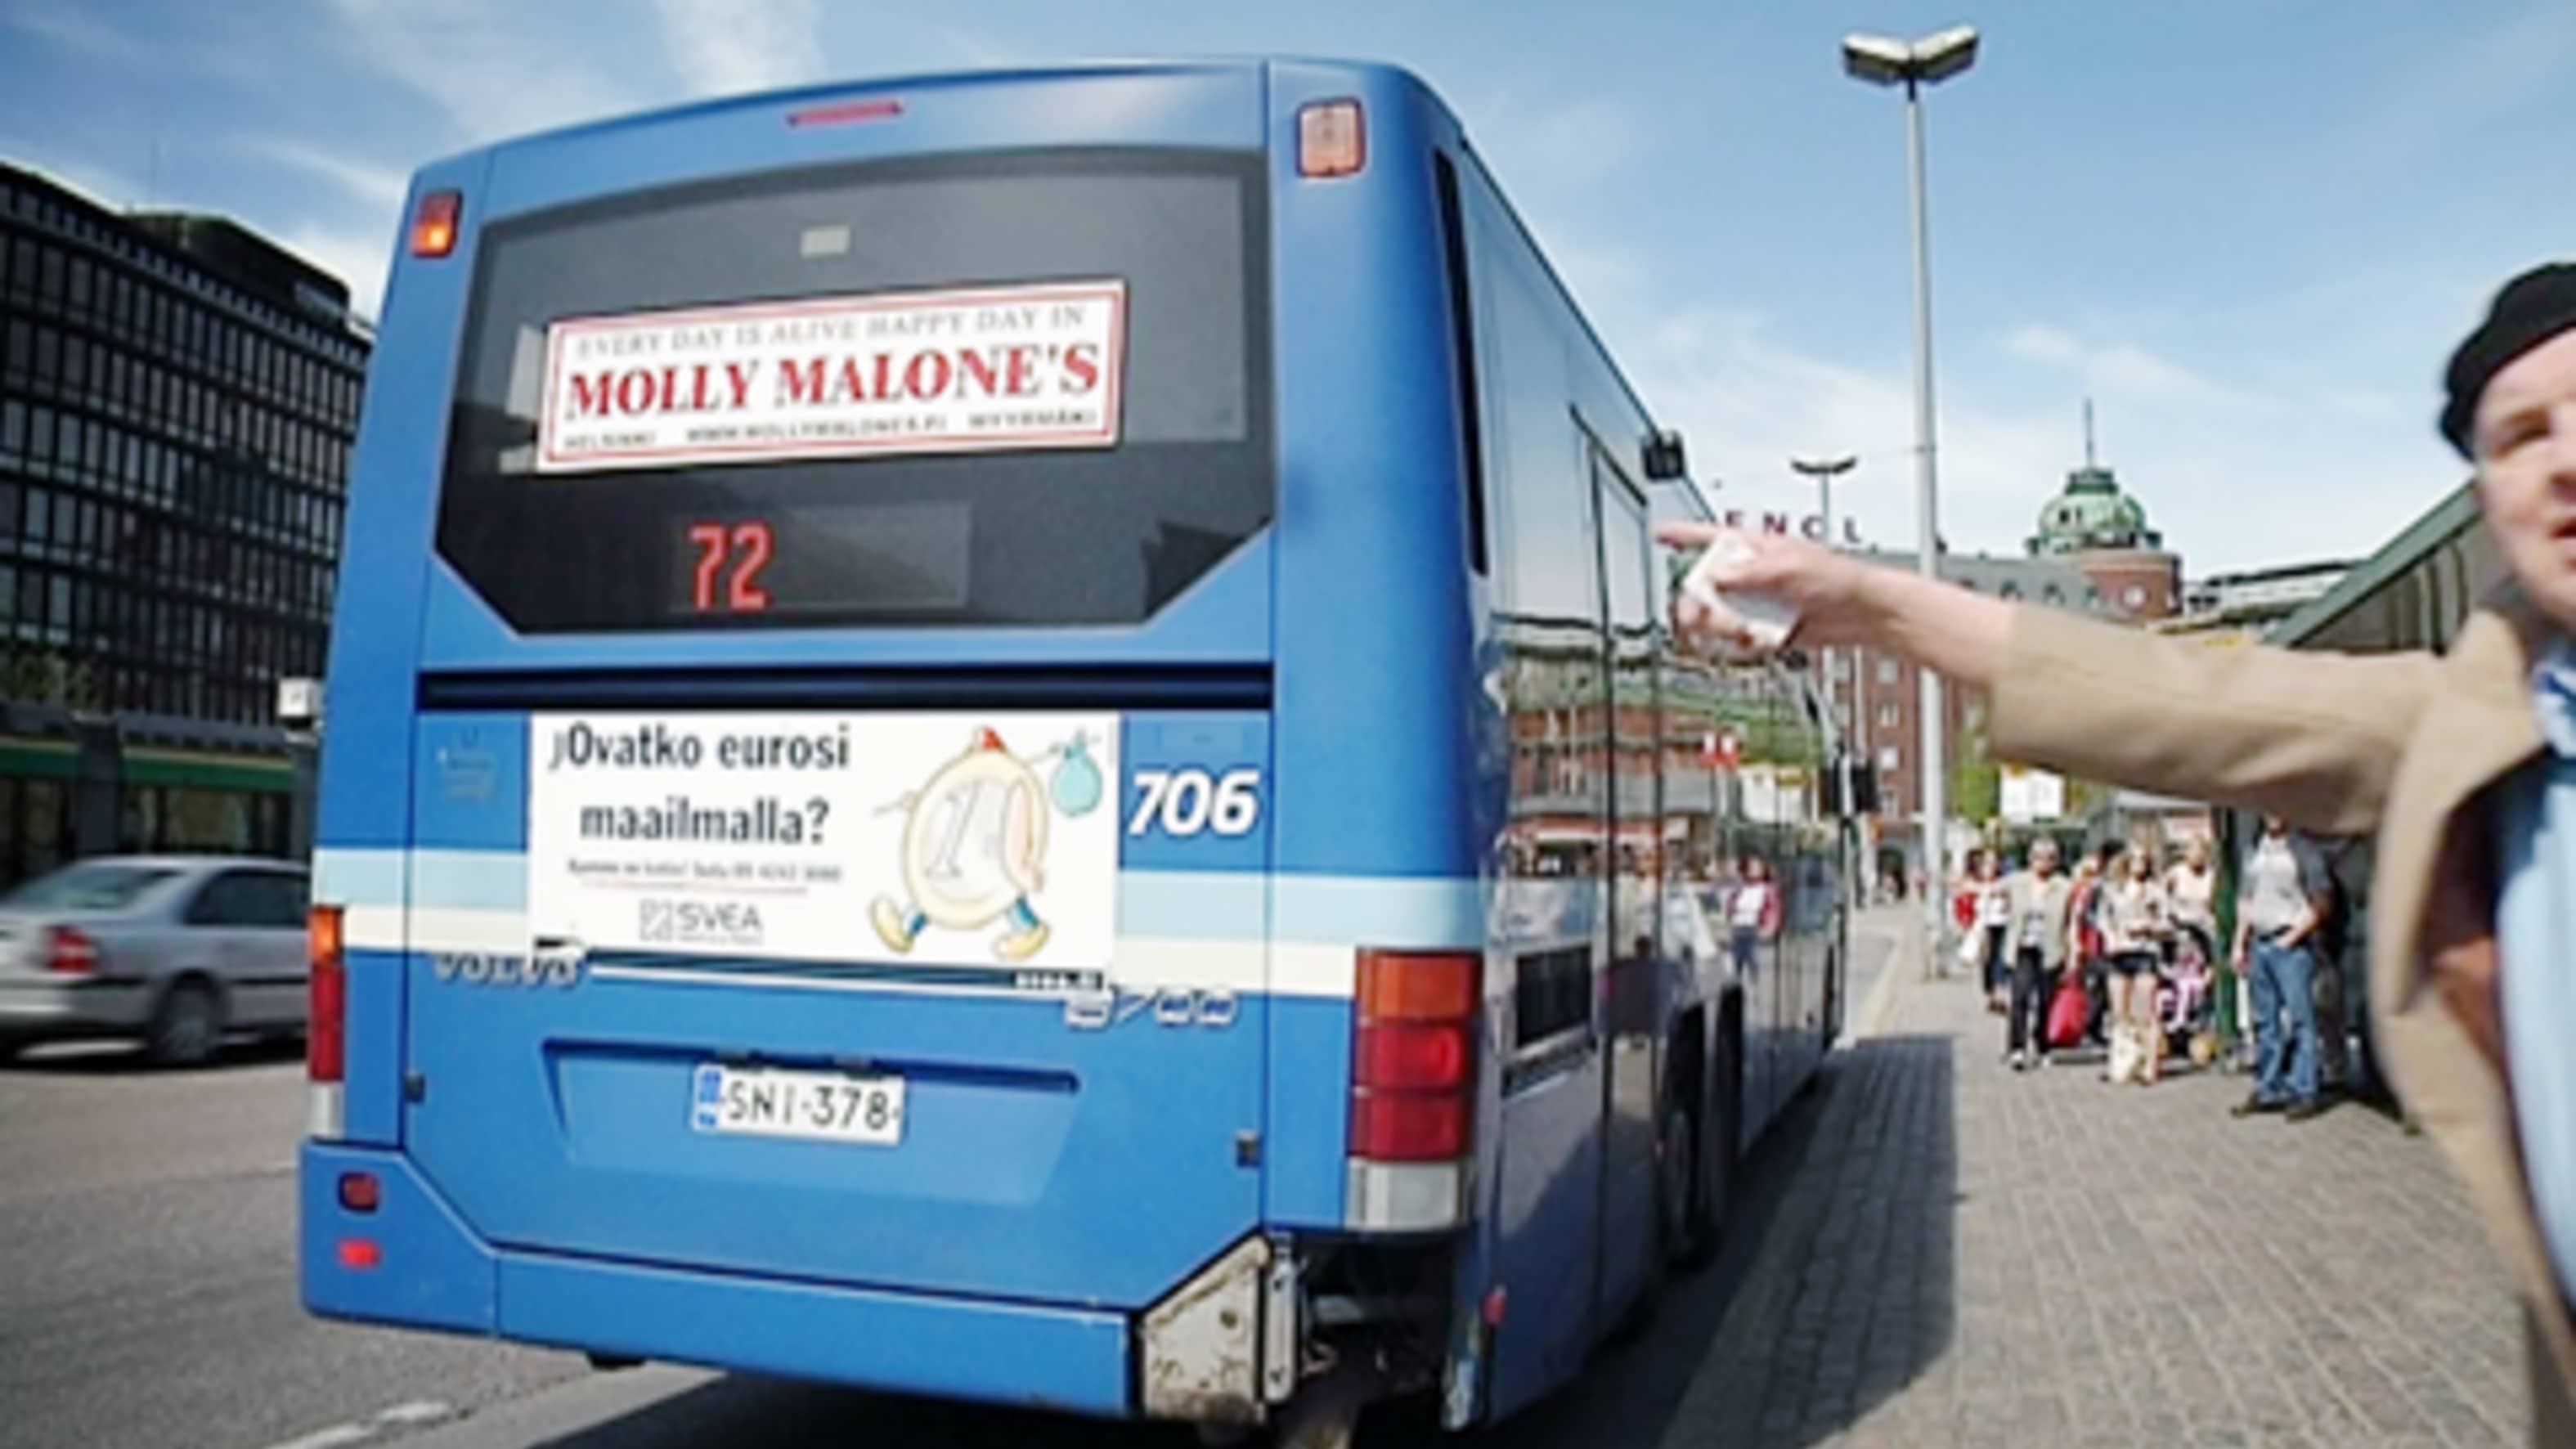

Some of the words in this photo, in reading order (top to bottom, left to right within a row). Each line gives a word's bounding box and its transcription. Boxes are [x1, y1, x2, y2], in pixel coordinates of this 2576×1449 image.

[577, 334, 663, 357] EVERY
[672, 327, 725, 350] DAY
[735, 324, 761, 344] IS
[770, 316, 858, 343] ALIVE
[866, 310, 967, 336] HAPPY
[976, 305, 1038, 329] DAY
[1052, 303, 1086, 325] IN
[565, 358, 761, 420] MOLLY
[774, 342, 1099, 408] MALONE'S
[689, 519, 774, 612] 72
[717, 721, 849, 769] eurosi
[579, 795, 831, 845] maailmalla?
[1128, 768, 1261, 835] 706
[675, 901, 765, 931] SVEA
[434, 949, 578, 987] VOLVO
[727, 1079, 891, 1132] SNI-378
